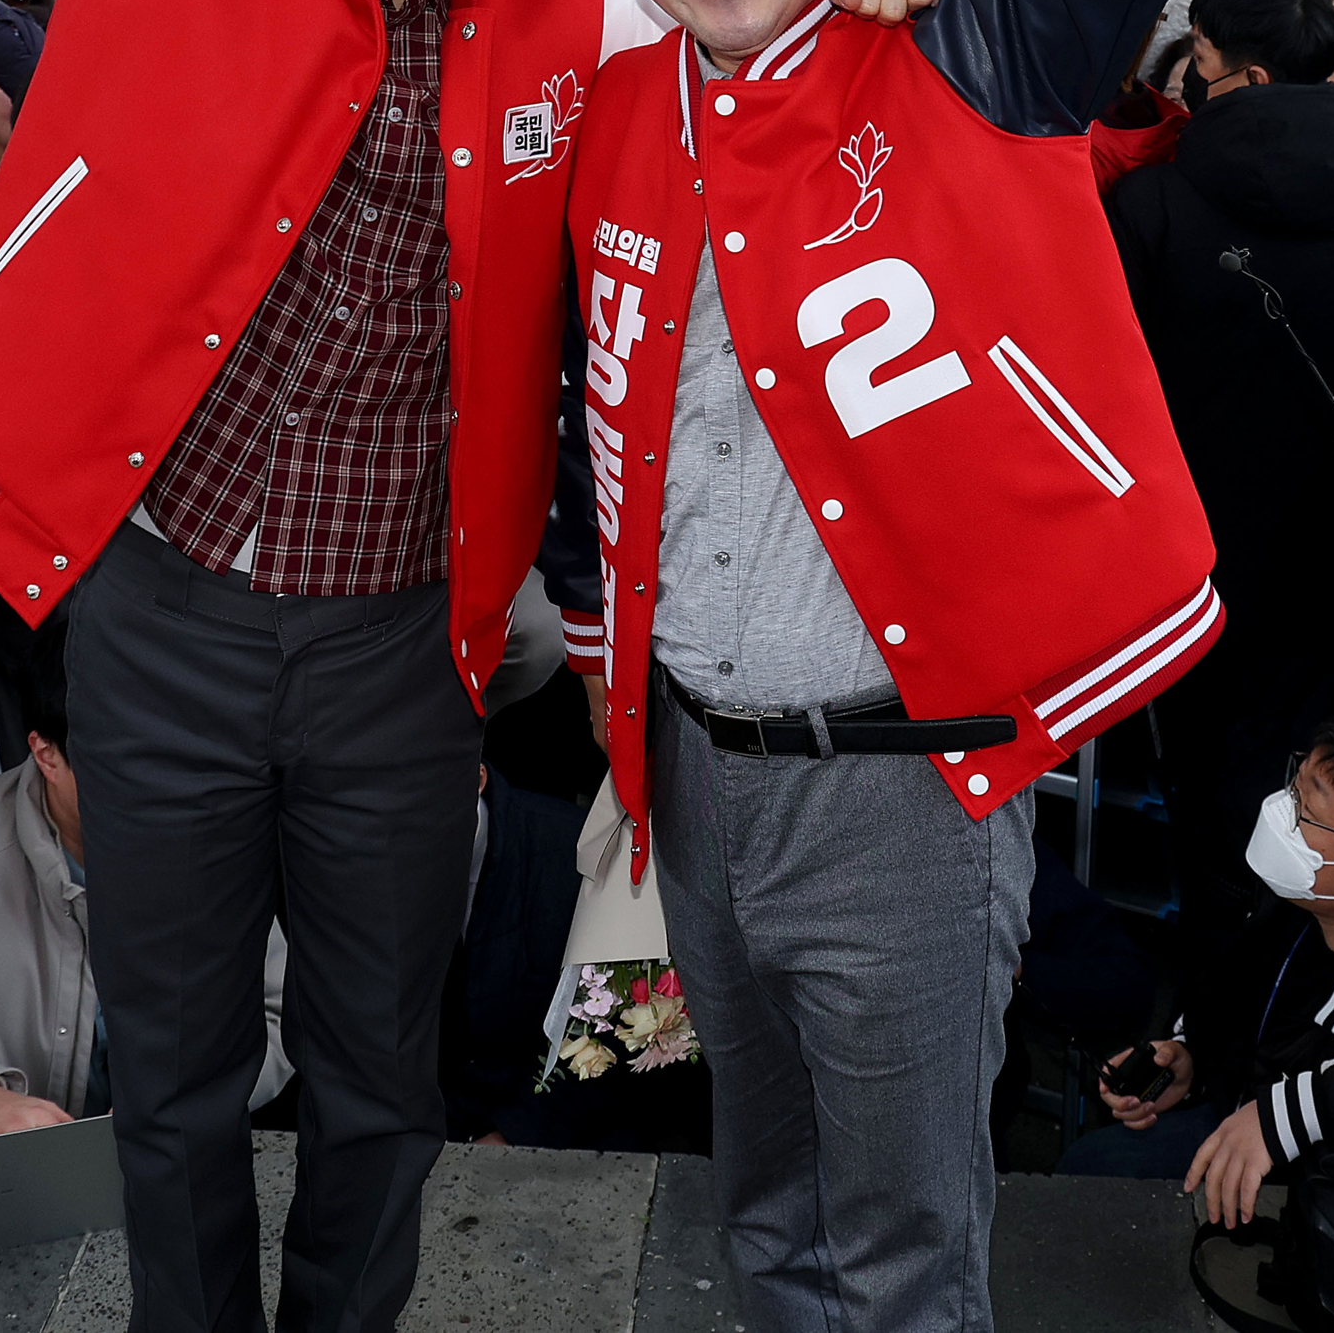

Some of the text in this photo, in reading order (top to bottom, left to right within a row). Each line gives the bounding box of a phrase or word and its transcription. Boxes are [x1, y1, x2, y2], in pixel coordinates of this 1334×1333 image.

[514, 113, 543, 133] 국민
[514, 131, 543, 151] 의힘
[796, 257, 970, 440] 2
